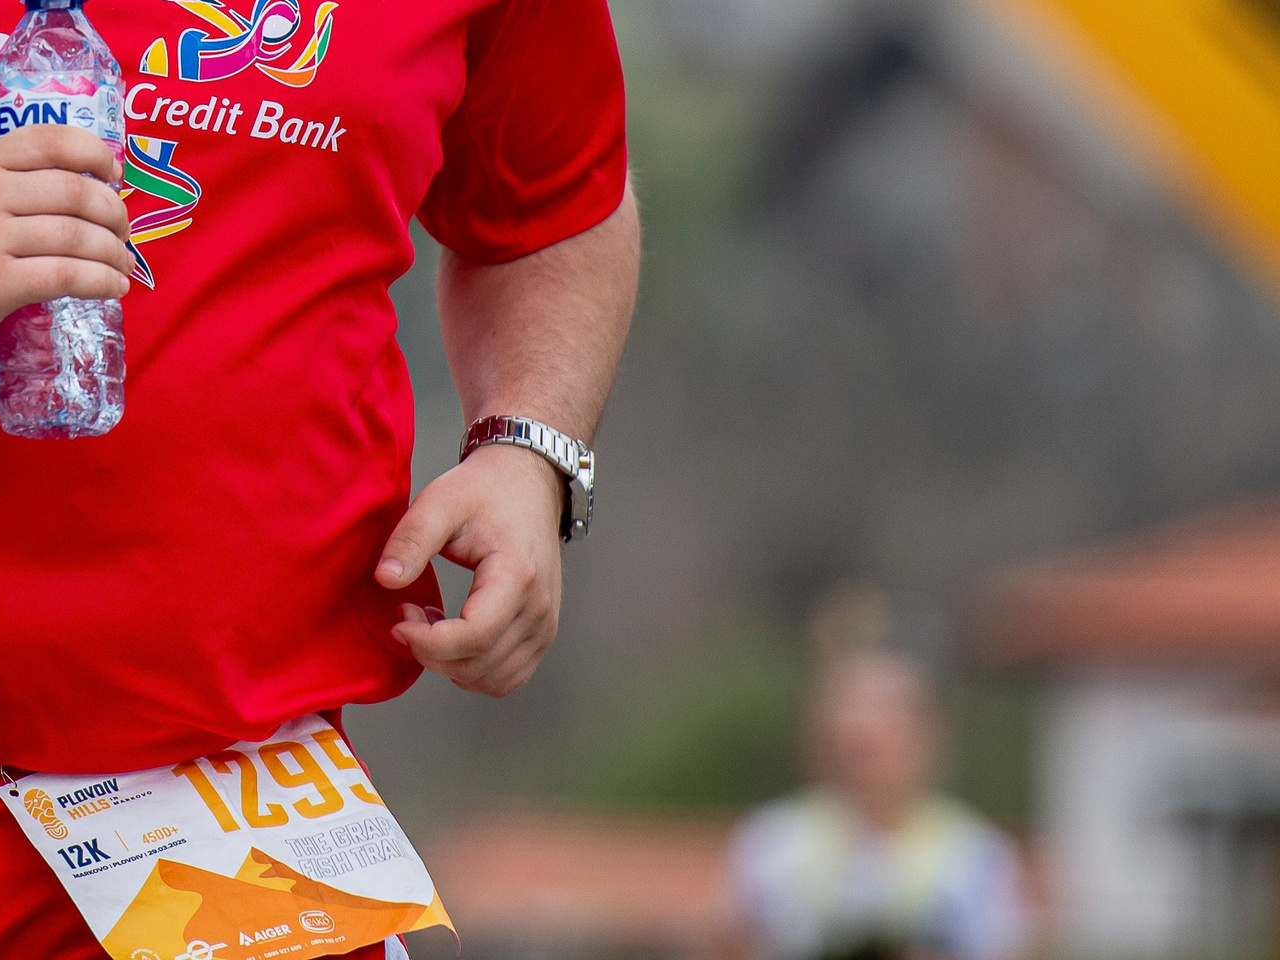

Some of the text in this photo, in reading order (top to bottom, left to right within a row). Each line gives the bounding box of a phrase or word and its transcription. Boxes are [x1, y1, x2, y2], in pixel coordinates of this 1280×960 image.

[124, 82, 243, 134] Credit
[250, 99, 347, 152] Bank
[56, 778, 120, 809] PLOVDIV
[113, 790, 153, 806] MARKOVO
[67, 798, 111, 820] HILLS
[57, 838, 111, 870] 12K
[72, 838, 187, 879] MARKOVO PLOVDIV 29.03.2025
[285, 832, 332, 858] THE
[298, 851, 354, 880] FISH
[254, 924, 293, 942] AIGER
